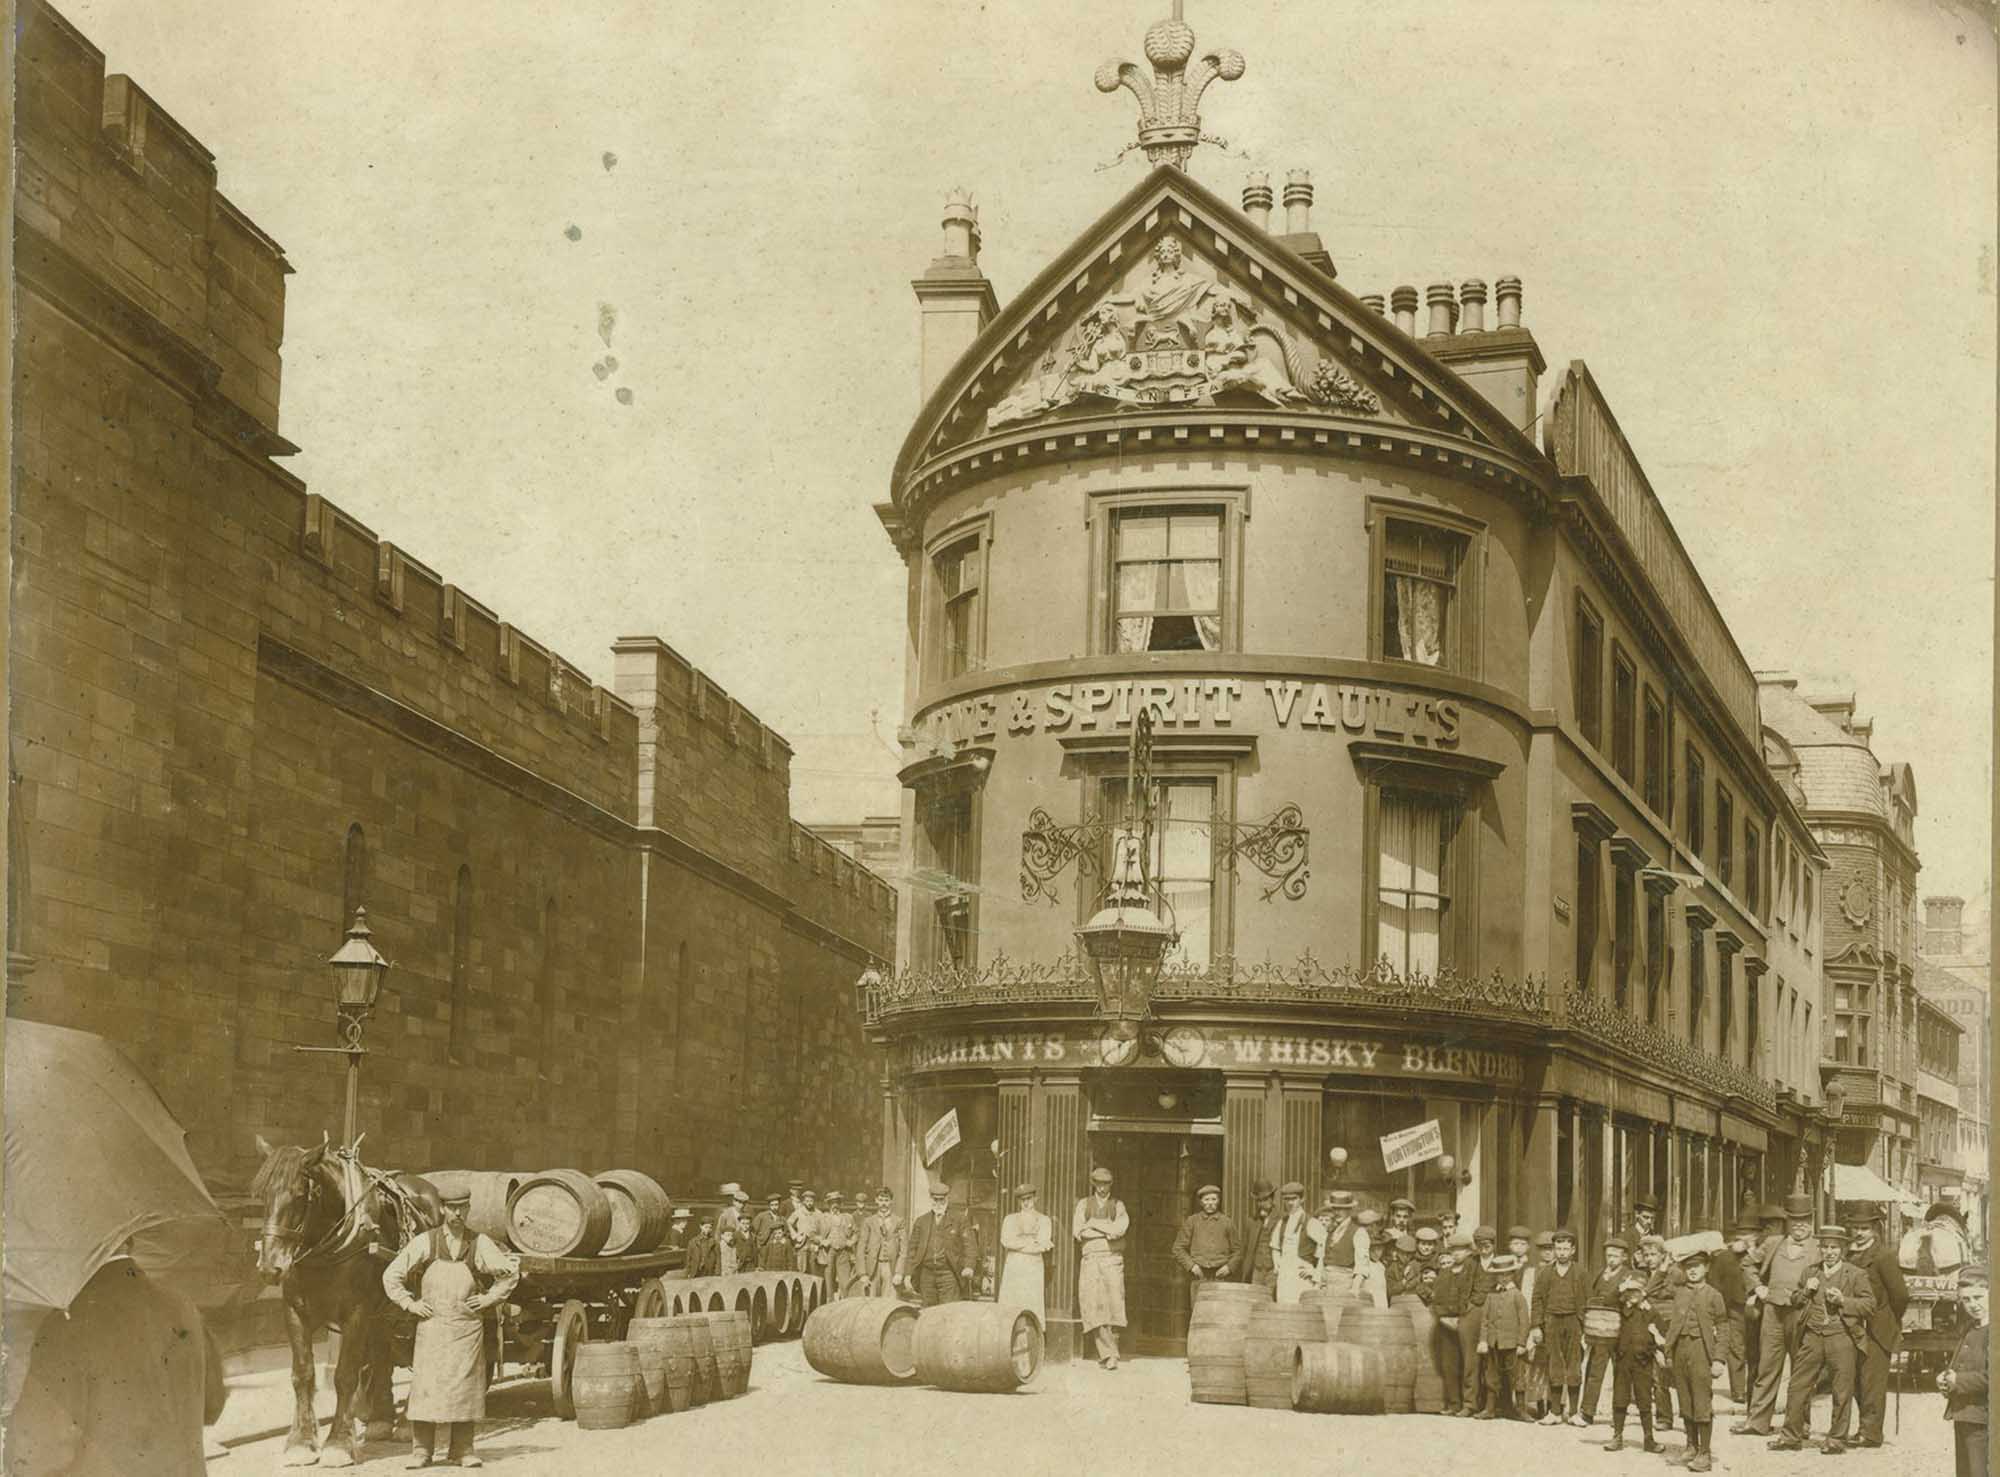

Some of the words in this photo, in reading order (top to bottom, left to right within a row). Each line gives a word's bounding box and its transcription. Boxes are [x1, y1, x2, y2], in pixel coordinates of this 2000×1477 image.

[1008, 689, 1036, 735] &
[1045, 679, 1241, 732] SPIRIT
[1264, 680, 1461, 746] VAULTS
[1230, 1034, 1383, 1069] WHISKY
